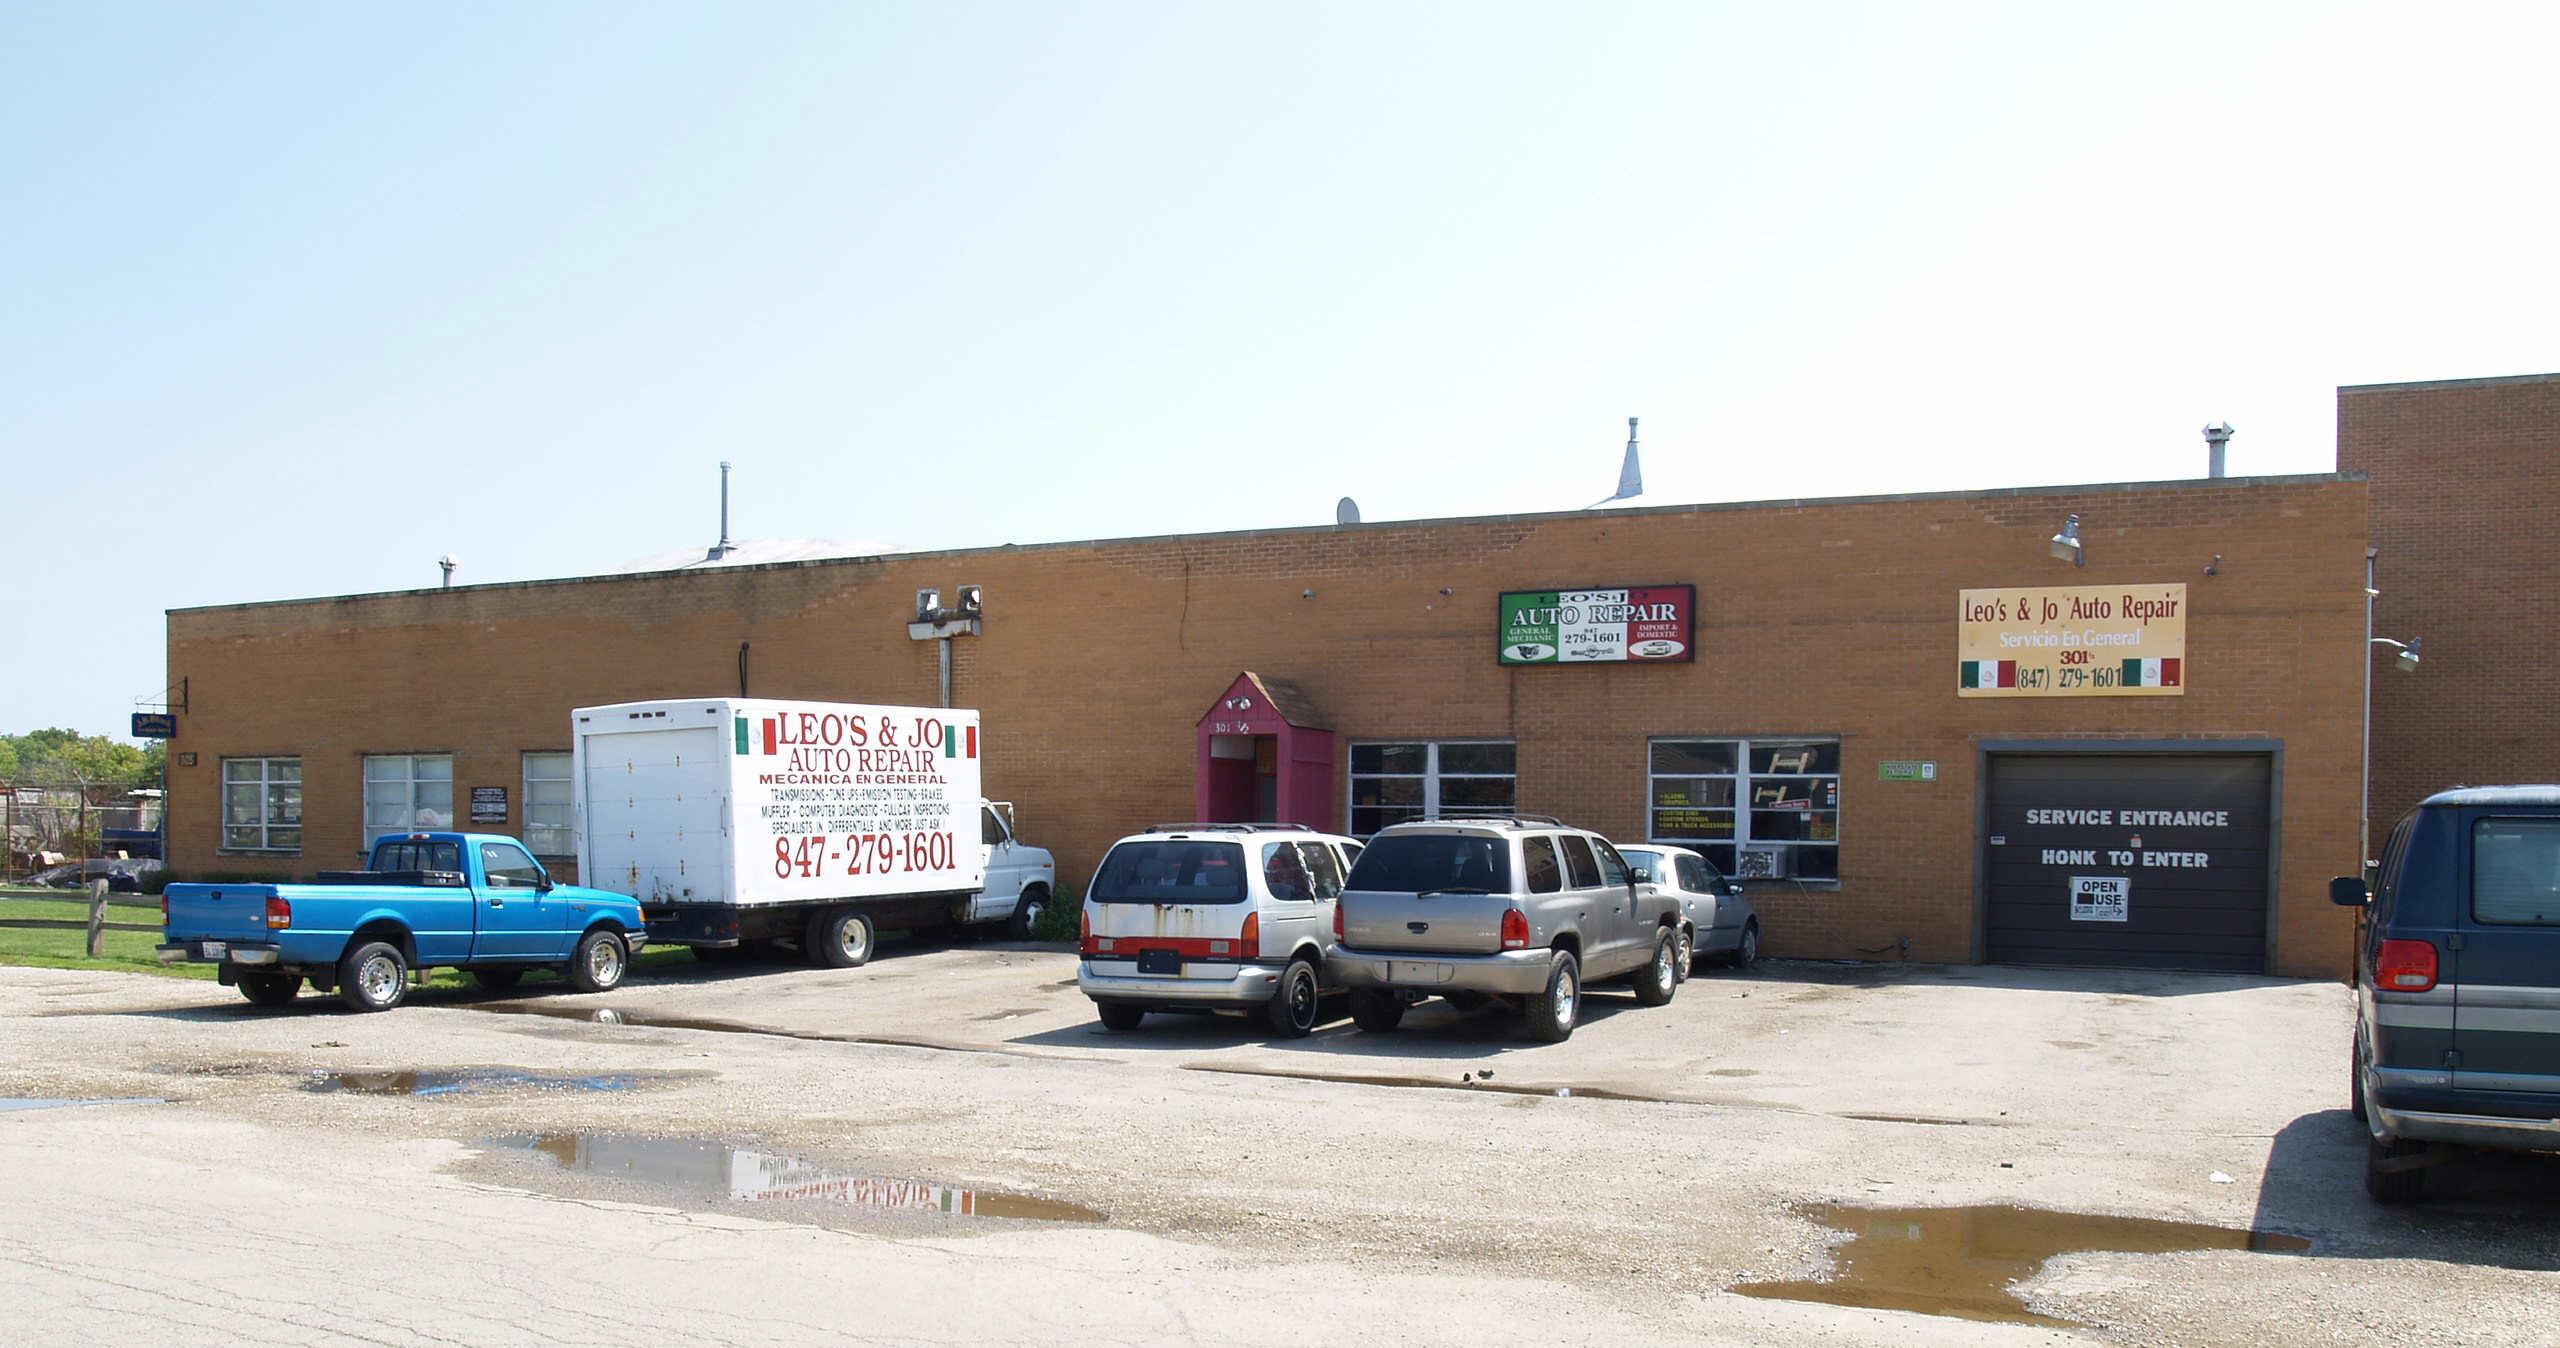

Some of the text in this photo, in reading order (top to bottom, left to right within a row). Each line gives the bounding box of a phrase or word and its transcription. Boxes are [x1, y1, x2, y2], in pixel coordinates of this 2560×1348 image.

[1511, 603, 1678, 626] AUTO REPAIR
[1964, 593, 2178, 626] Leo's & Jo Auto Repair
[1509, 627, 1550, 635] GENERAL
[1636, 630, 1679, 639] DOMESTIC
[1639, 623, 1669, 631] IMPORT
[1507, 634, 1554, 643] MECHANIC
[1565, 632, 1621, 643] 279-1601
[2000, 628, 2141, 648] Servicio En General
[2060, 650, 2089, 665] 301
[2016, 665, 2122, 692] (847) 279-1601
[778, 711, 943, 749] LEO'S & JO
[1215, 723, 1230, 733] 301
[788, 747, 936, 773] AUTO REPAIR
[759, 774, 948, 785] MECANICA EN GENERAL
[761, 804, 791, 818] MUFFLER
[799, 804, 836, 817] COMPUTER
[839, 804, 878, 817] DIAGNOSTIC
[914, 803, 950, 815] INSPECTIONS
[2026, 809, 2229, 827] SERVICE ENTRANCE
[772, 821, 813, 834] SPECIALISTS
[816, 821, 824, 833] IN
[828, 820, 874, 833] DIFFERENTIALS
[879, 819, 892, 832] AND
[895, 818, 912, 831] MORE
[914, 818, 928, 830] JUST
[2041, 849, 2209, 868] HONK TO ENTER
[2082, 881, 2118, 892] OPEN
[2095, 894, 2122, 905] USE
